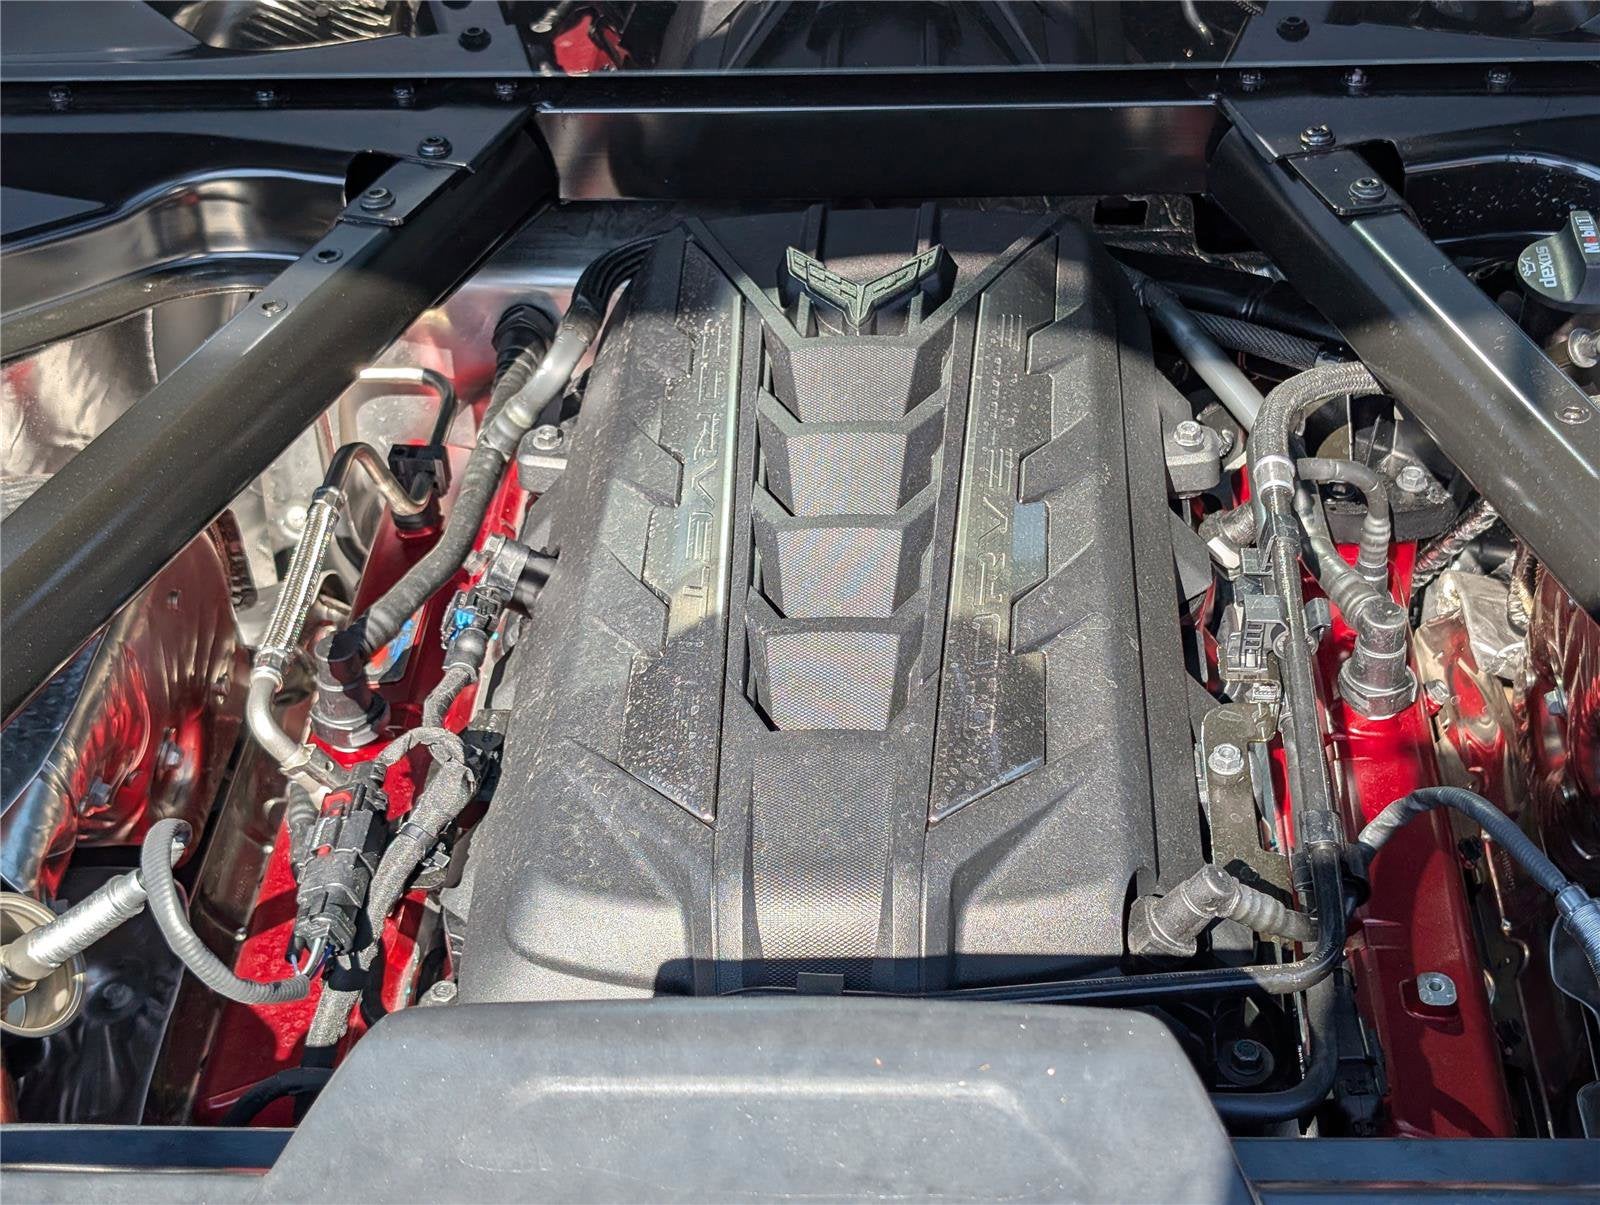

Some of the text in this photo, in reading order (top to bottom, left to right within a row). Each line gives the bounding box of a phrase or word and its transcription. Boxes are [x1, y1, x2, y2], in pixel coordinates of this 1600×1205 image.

[1579, 226, 1600, 253] Mobil
[1536, 246, 1558, 288] dexos
[676, 318, 722, 742] CORVET
